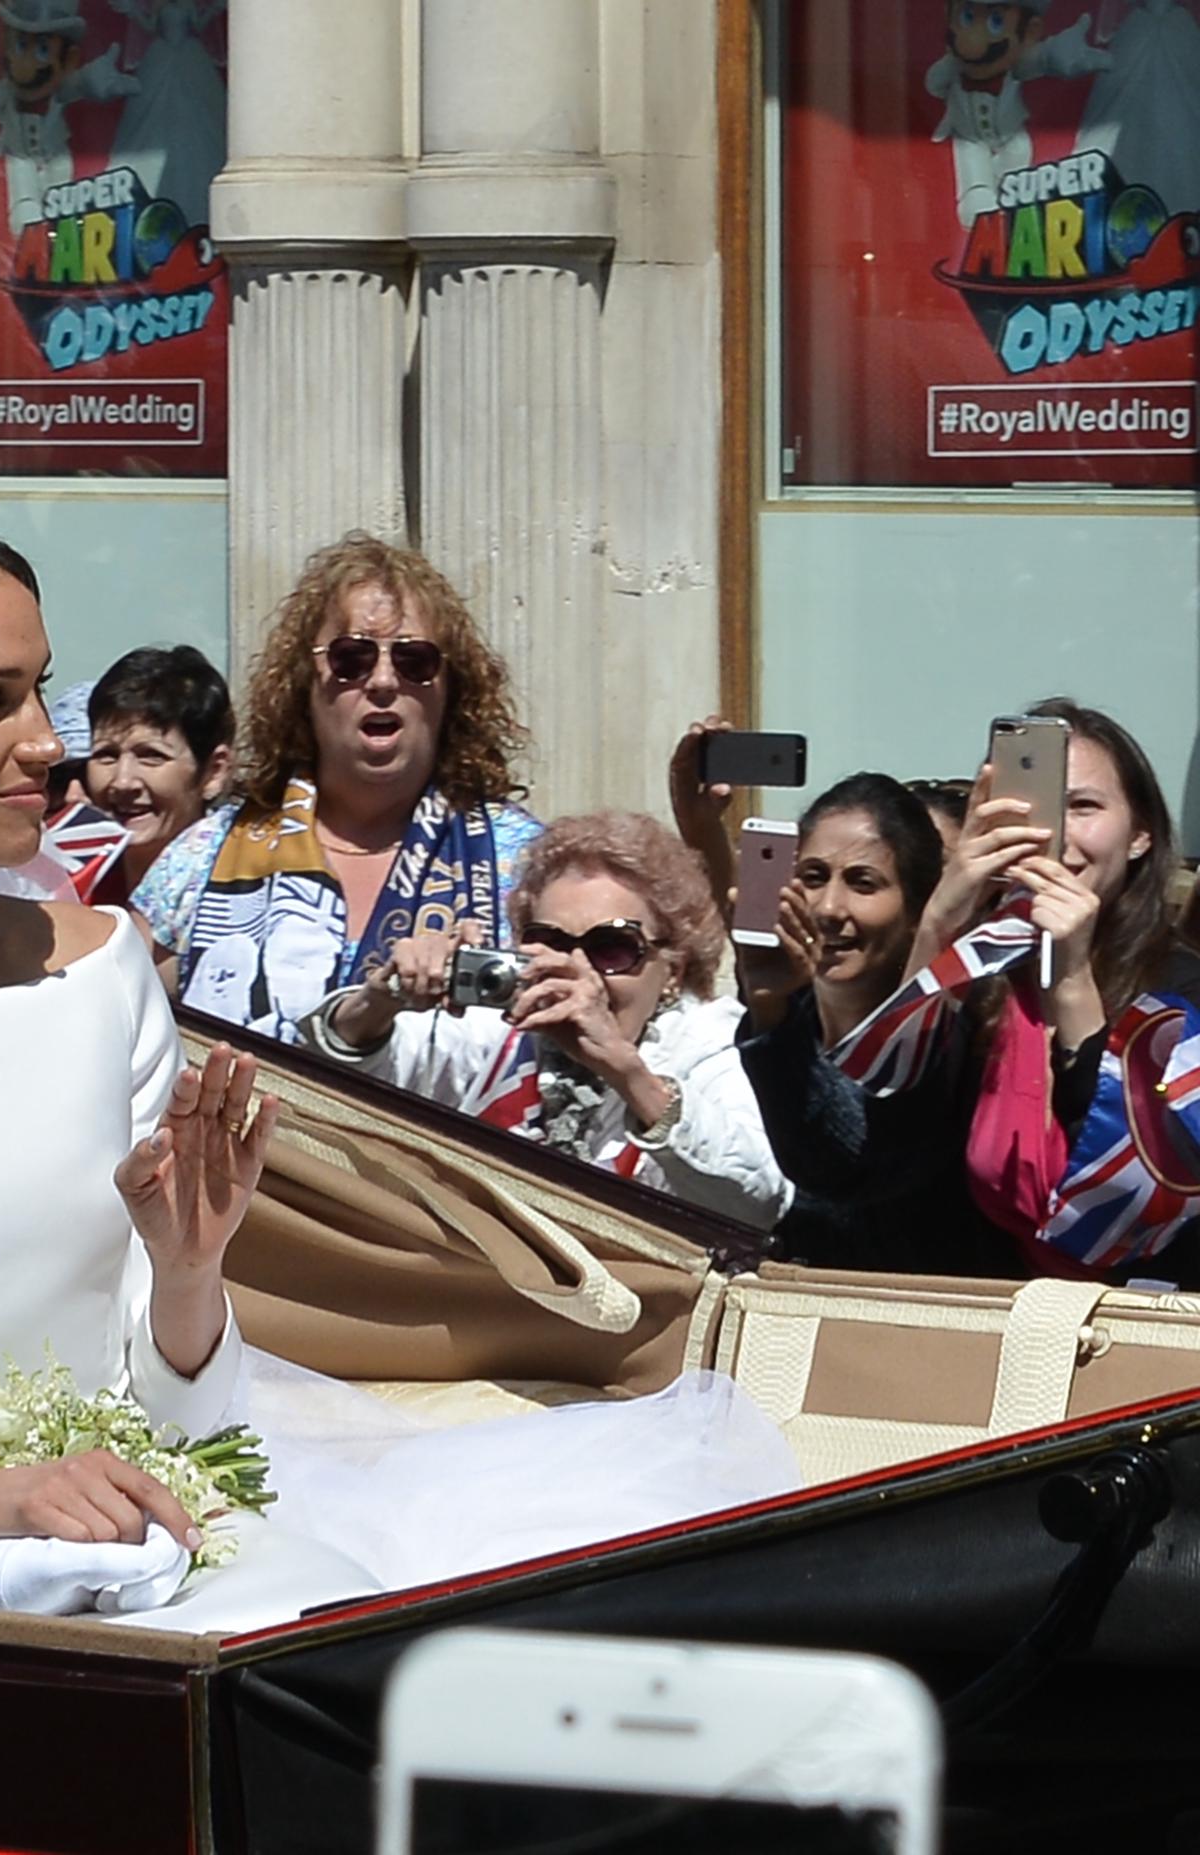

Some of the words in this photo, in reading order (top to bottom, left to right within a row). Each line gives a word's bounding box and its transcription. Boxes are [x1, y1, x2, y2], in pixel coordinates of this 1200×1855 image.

[44, 169, 135, 219] SUPER
[1000, 152, 1106, 208] SUPER
[44, 291, 214, 369] ODYSSEY
[1001, 287, 1199, 373] ODYSSEY
[939, 398, 1190, 441] #RoyalWedding
[387, 843, 430, 898] The
